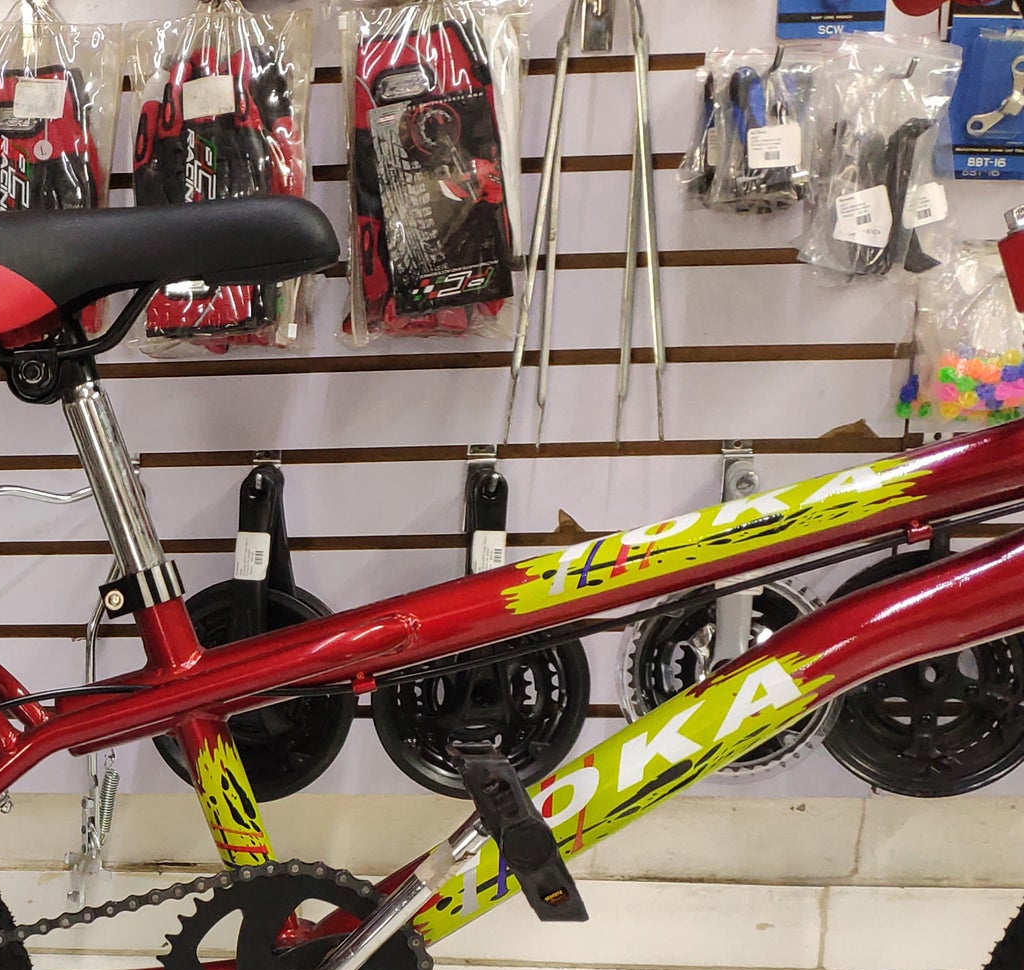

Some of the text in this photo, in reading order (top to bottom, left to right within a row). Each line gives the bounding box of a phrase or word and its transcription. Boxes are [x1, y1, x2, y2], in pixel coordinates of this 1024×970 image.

[817, 25, 844, 35] SCW
[0, 135, 9, 211] RACIN
[184, 128, 195, 203] RACIN
[548, 465, 885, 597] TOKA
